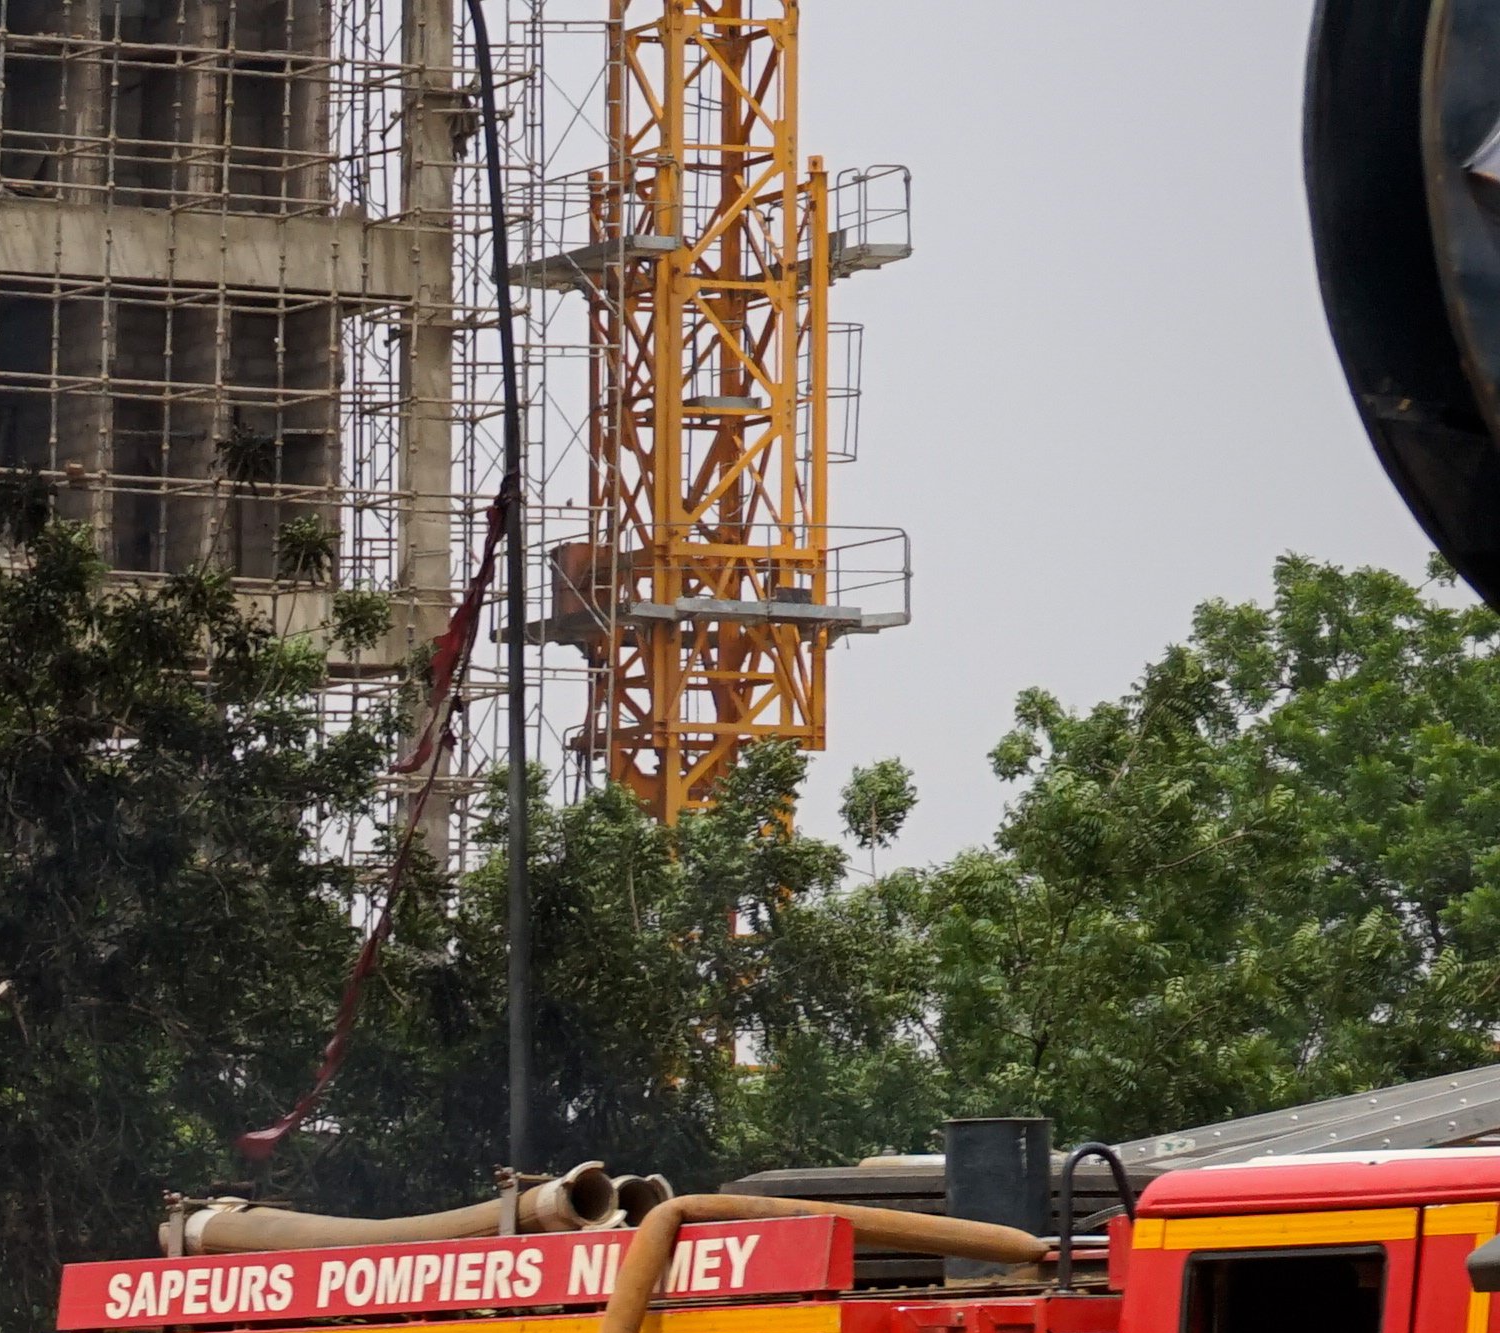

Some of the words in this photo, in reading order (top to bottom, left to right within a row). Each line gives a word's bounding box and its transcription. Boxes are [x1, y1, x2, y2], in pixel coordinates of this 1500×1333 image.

[105, 1263, 295, 1320] SAPEURS
[316, 1247, 544, 1308] POMPIERS
[567, 1234, 760, 1296] NIMEY
